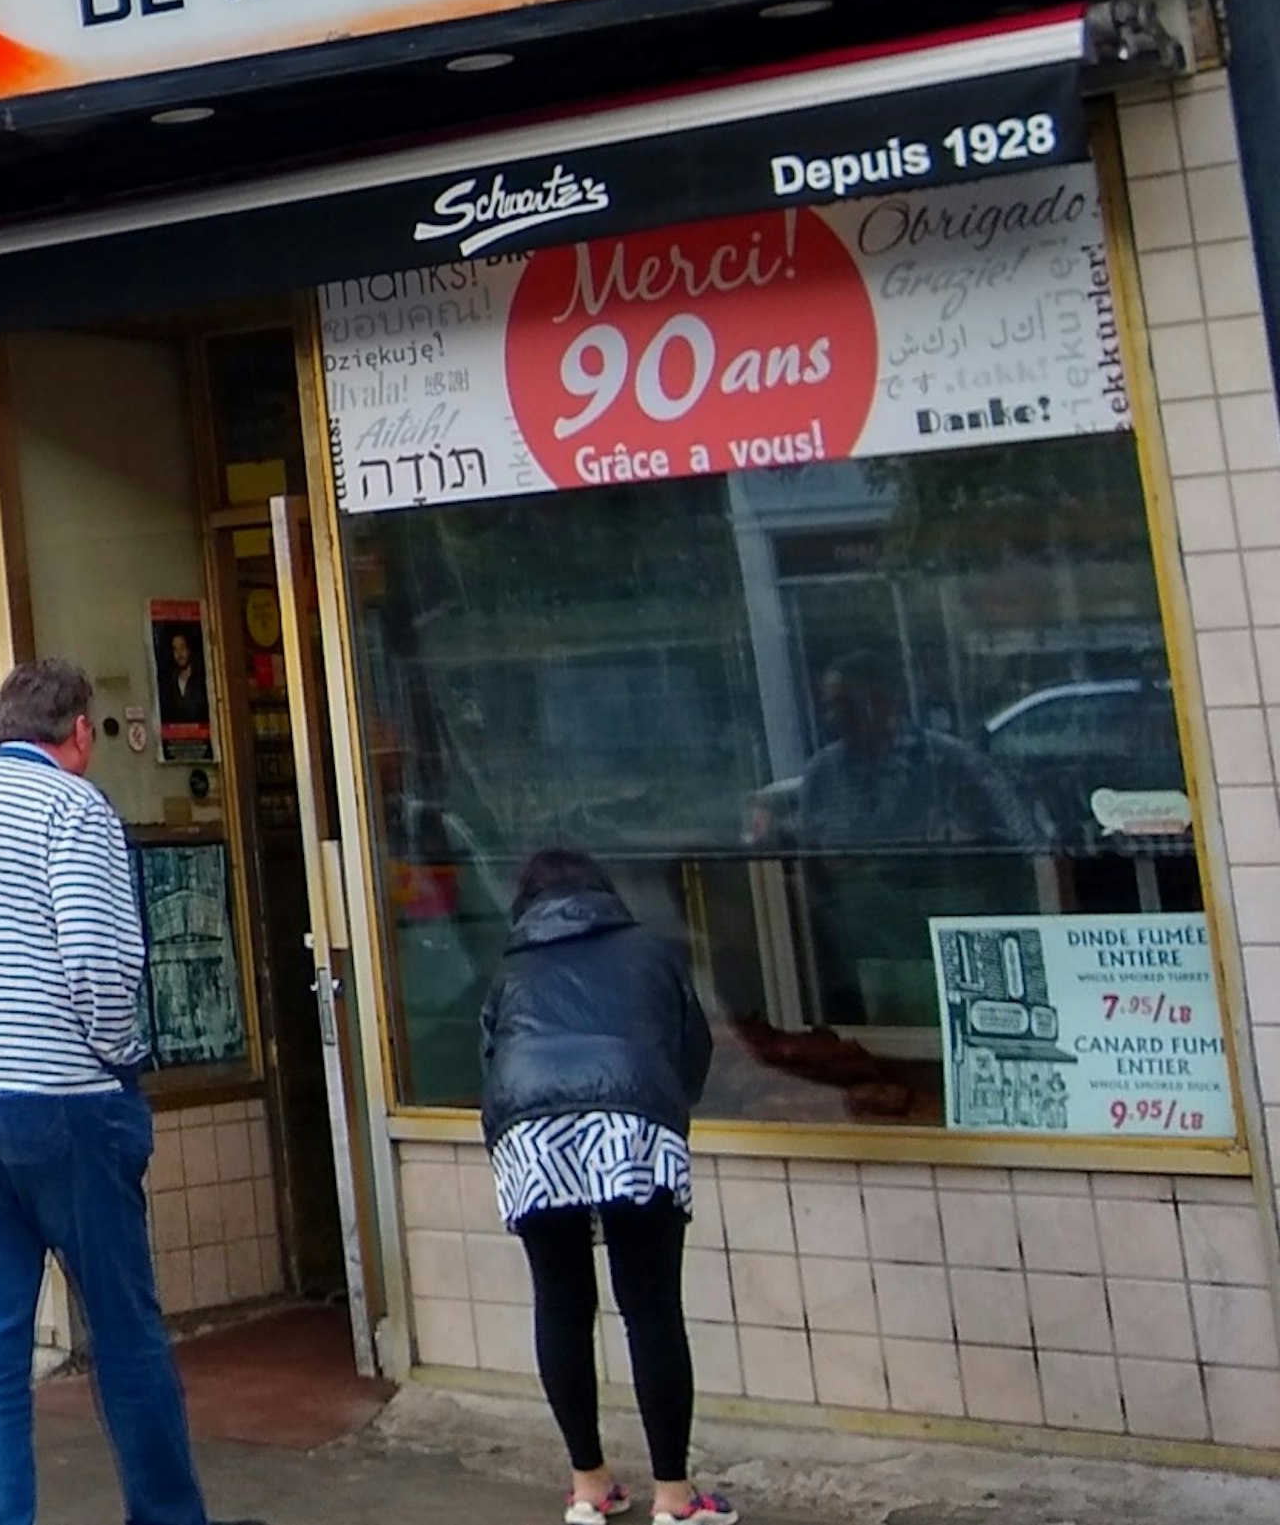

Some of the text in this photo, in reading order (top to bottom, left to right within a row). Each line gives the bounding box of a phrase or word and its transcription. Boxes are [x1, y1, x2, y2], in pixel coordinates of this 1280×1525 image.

[771, 113, 1056, 197] Depuis 1928
[413, 164, 609, 257] Schwartz's
[551, 207, 799, 326] Merci!
[553, 312, 831, 442] 90 ans
[916, 396, 1051, 434] Danke!
[574, 443, 669, 485] Grâce
[730, 418, 826, 470] vous!
[1067, 926, 1208, 946] DINDE FUMÉE
[1097, 948, 1182, 967] ENTIÈRE
[1074, 1036, 1163, 1053] CANARD
[1117, 1058, 1191, 1075] ENTIER
